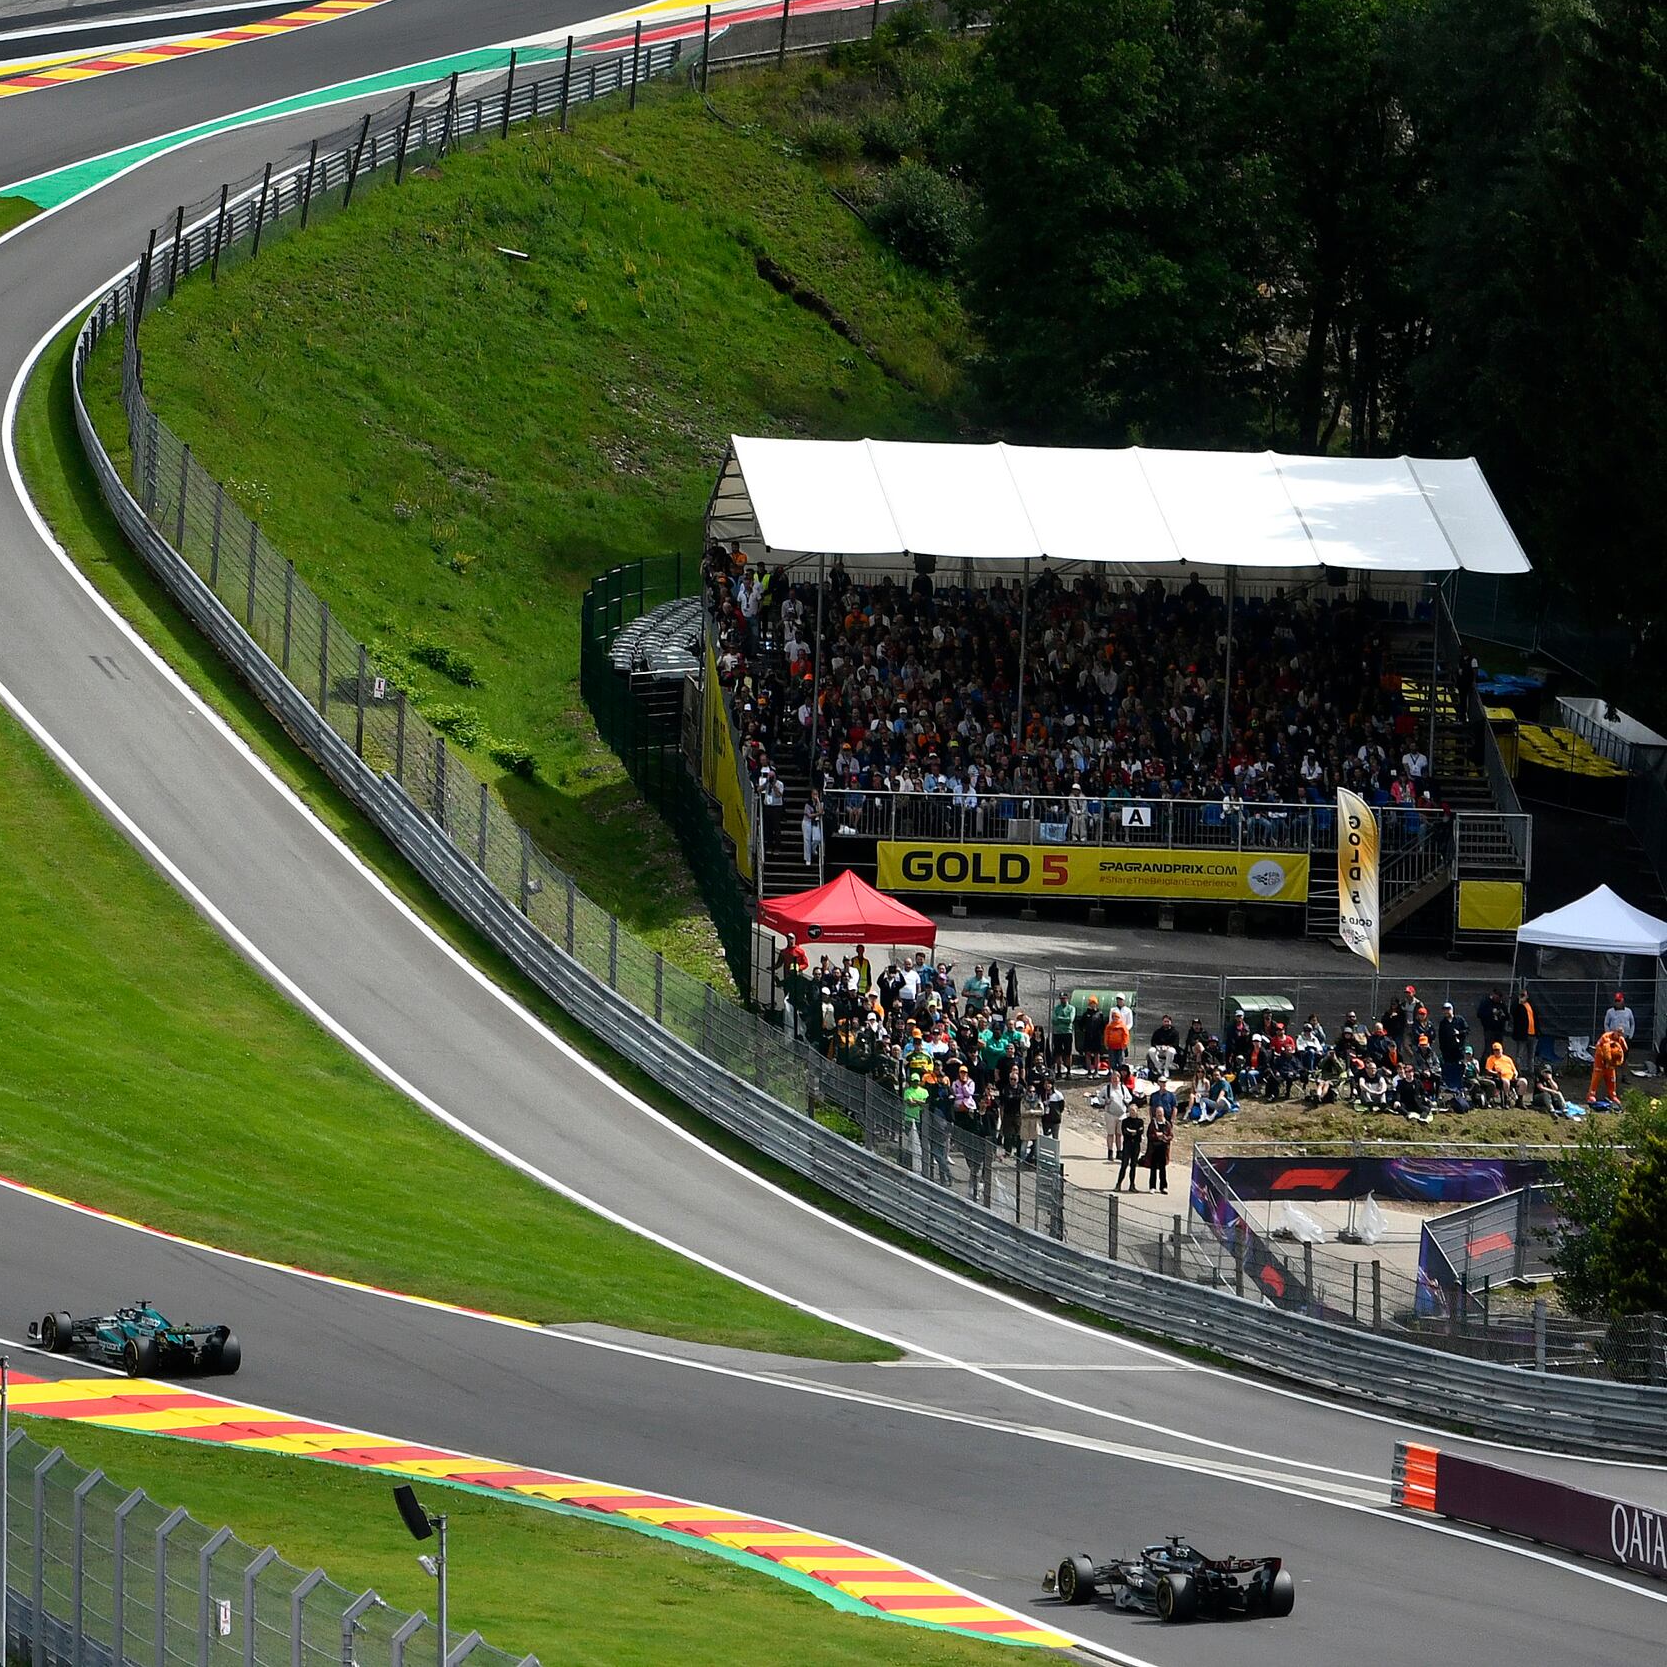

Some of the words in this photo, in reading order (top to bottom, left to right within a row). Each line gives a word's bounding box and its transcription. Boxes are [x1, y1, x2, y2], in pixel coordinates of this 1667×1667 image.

[1128, 808, 1144, 826] A
[901, 851, 1031, 884] GOLD
[1042, 855, 1068, 886] 5
[1099, 861, 1238, 876] SPAGRANDPRIX.COM
[1099, 876, 1238, 888] #ShareTheBelgianExperience
[1214, 1558, 1267, 1572] INEOS
